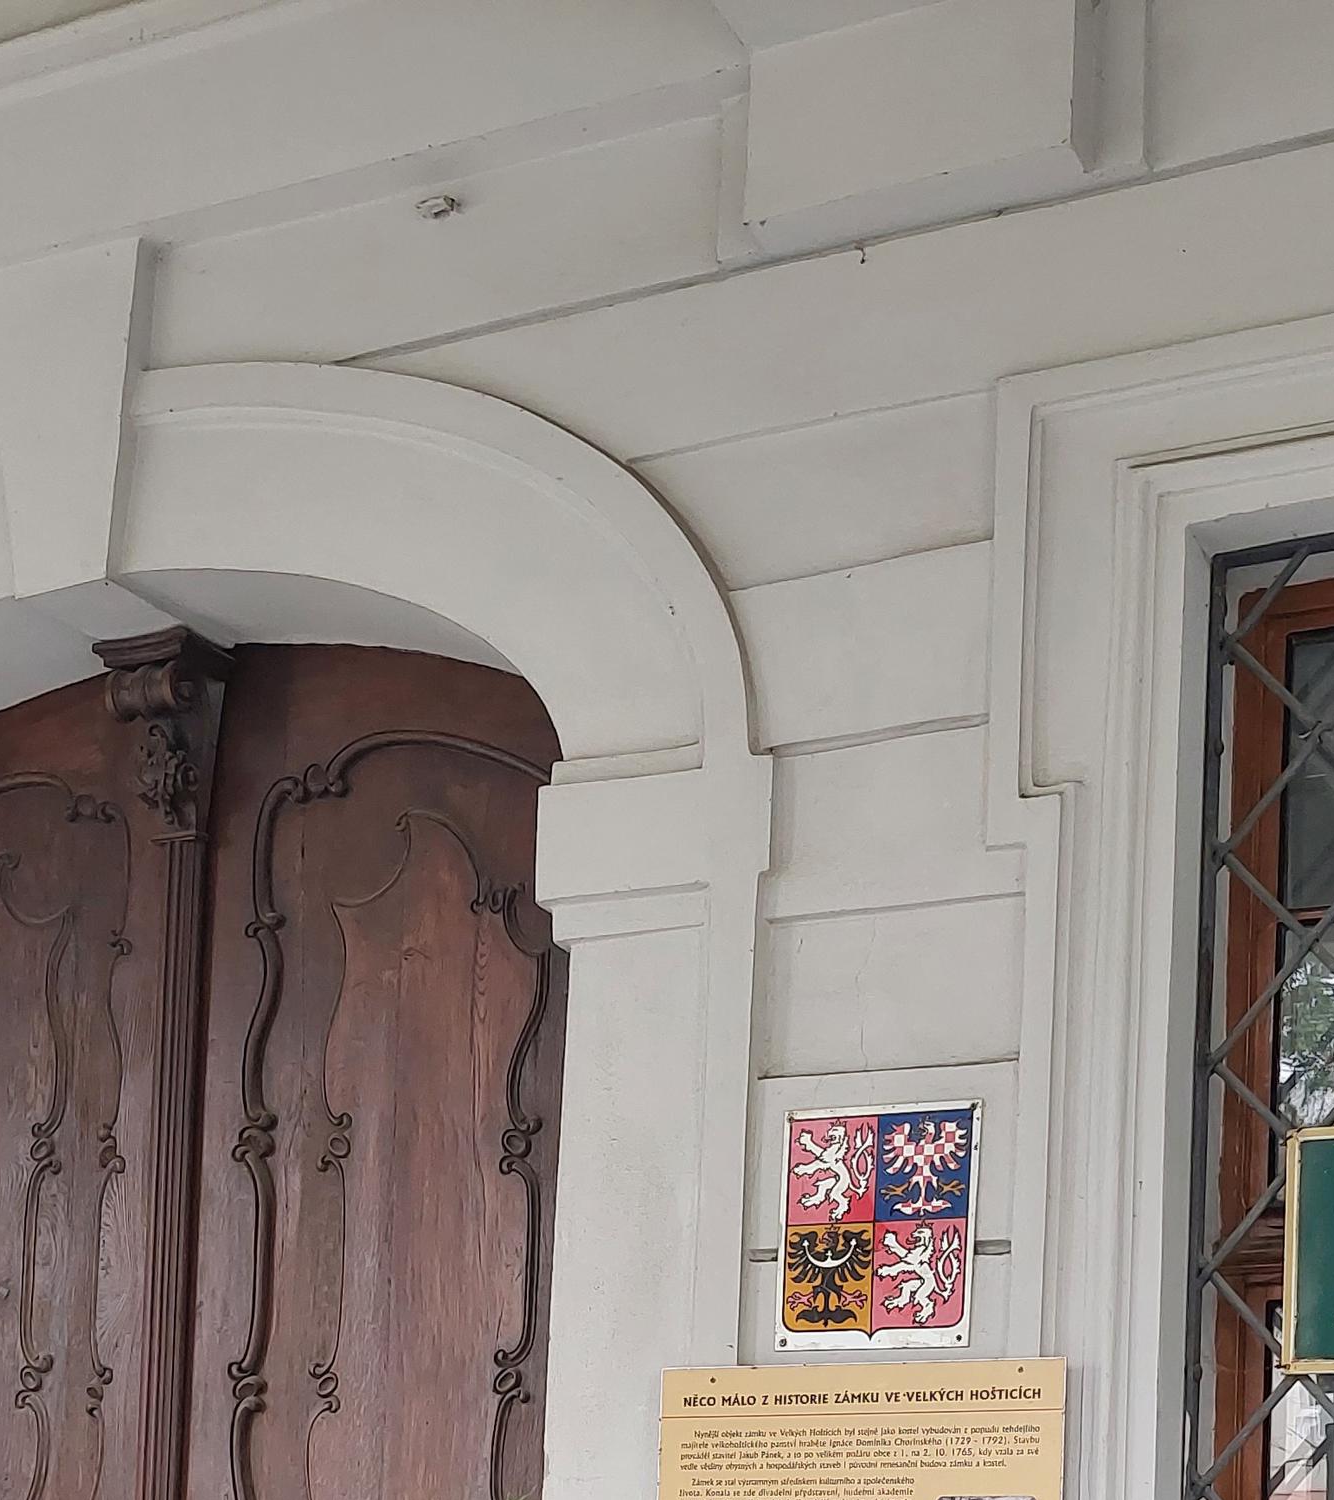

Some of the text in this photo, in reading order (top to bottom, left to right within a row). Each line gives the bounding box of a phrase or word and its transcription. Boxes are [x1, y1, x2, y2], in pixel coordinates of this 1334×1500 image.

[683, 1385, 1041, 1407] NĚCO MÁLO Z HISTORIE ZÁMKU VE VELKÝCH HOŠTICÍCH
